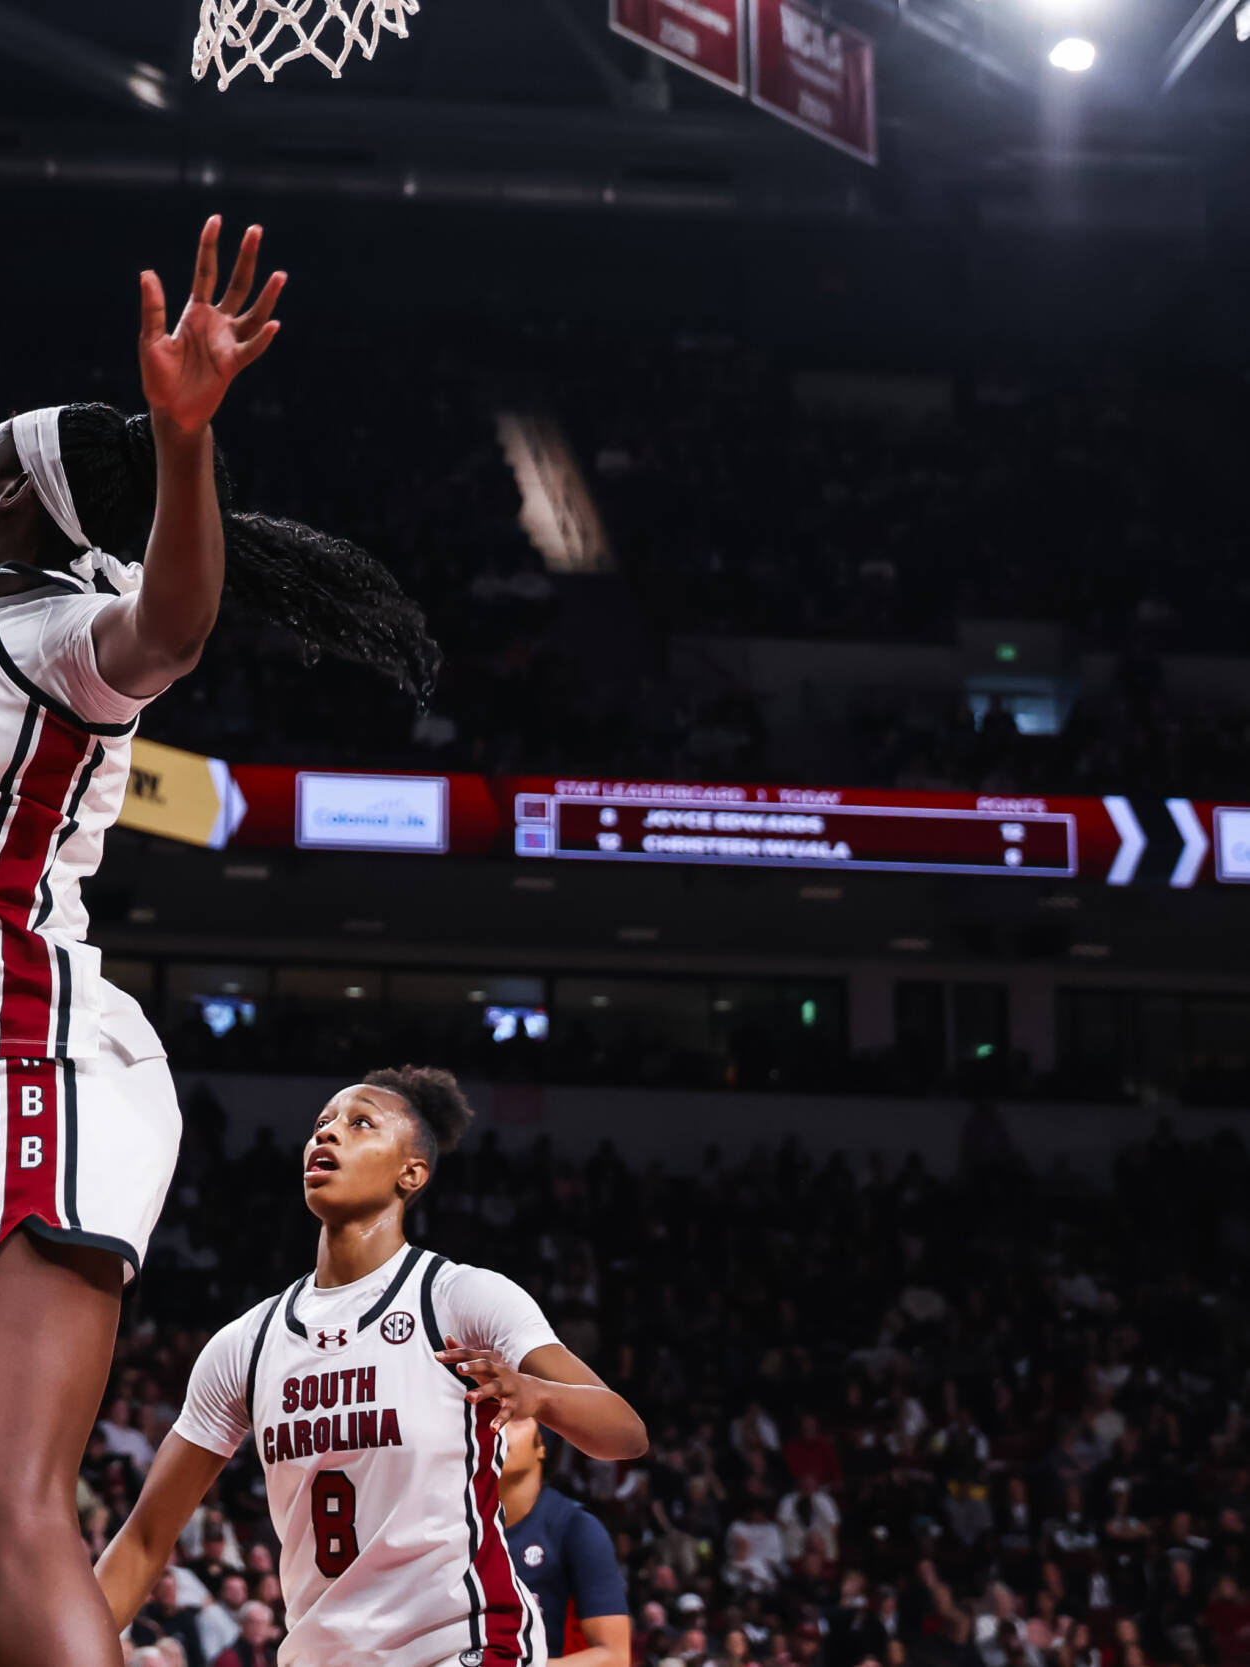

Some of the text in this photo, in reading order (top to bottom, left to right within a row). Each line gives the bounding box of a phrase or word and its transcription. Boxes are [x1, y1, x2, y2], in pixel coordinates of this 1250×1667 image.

[602, 782, 747, 803] LEADERBOARD
[381, 1312, 414, 1343] SEC
[282, 1366, 377, 1414] SOUTH
[263, 1408, 403, 1464] CAROLINA
[311, 1470, 360, 1579] 8
